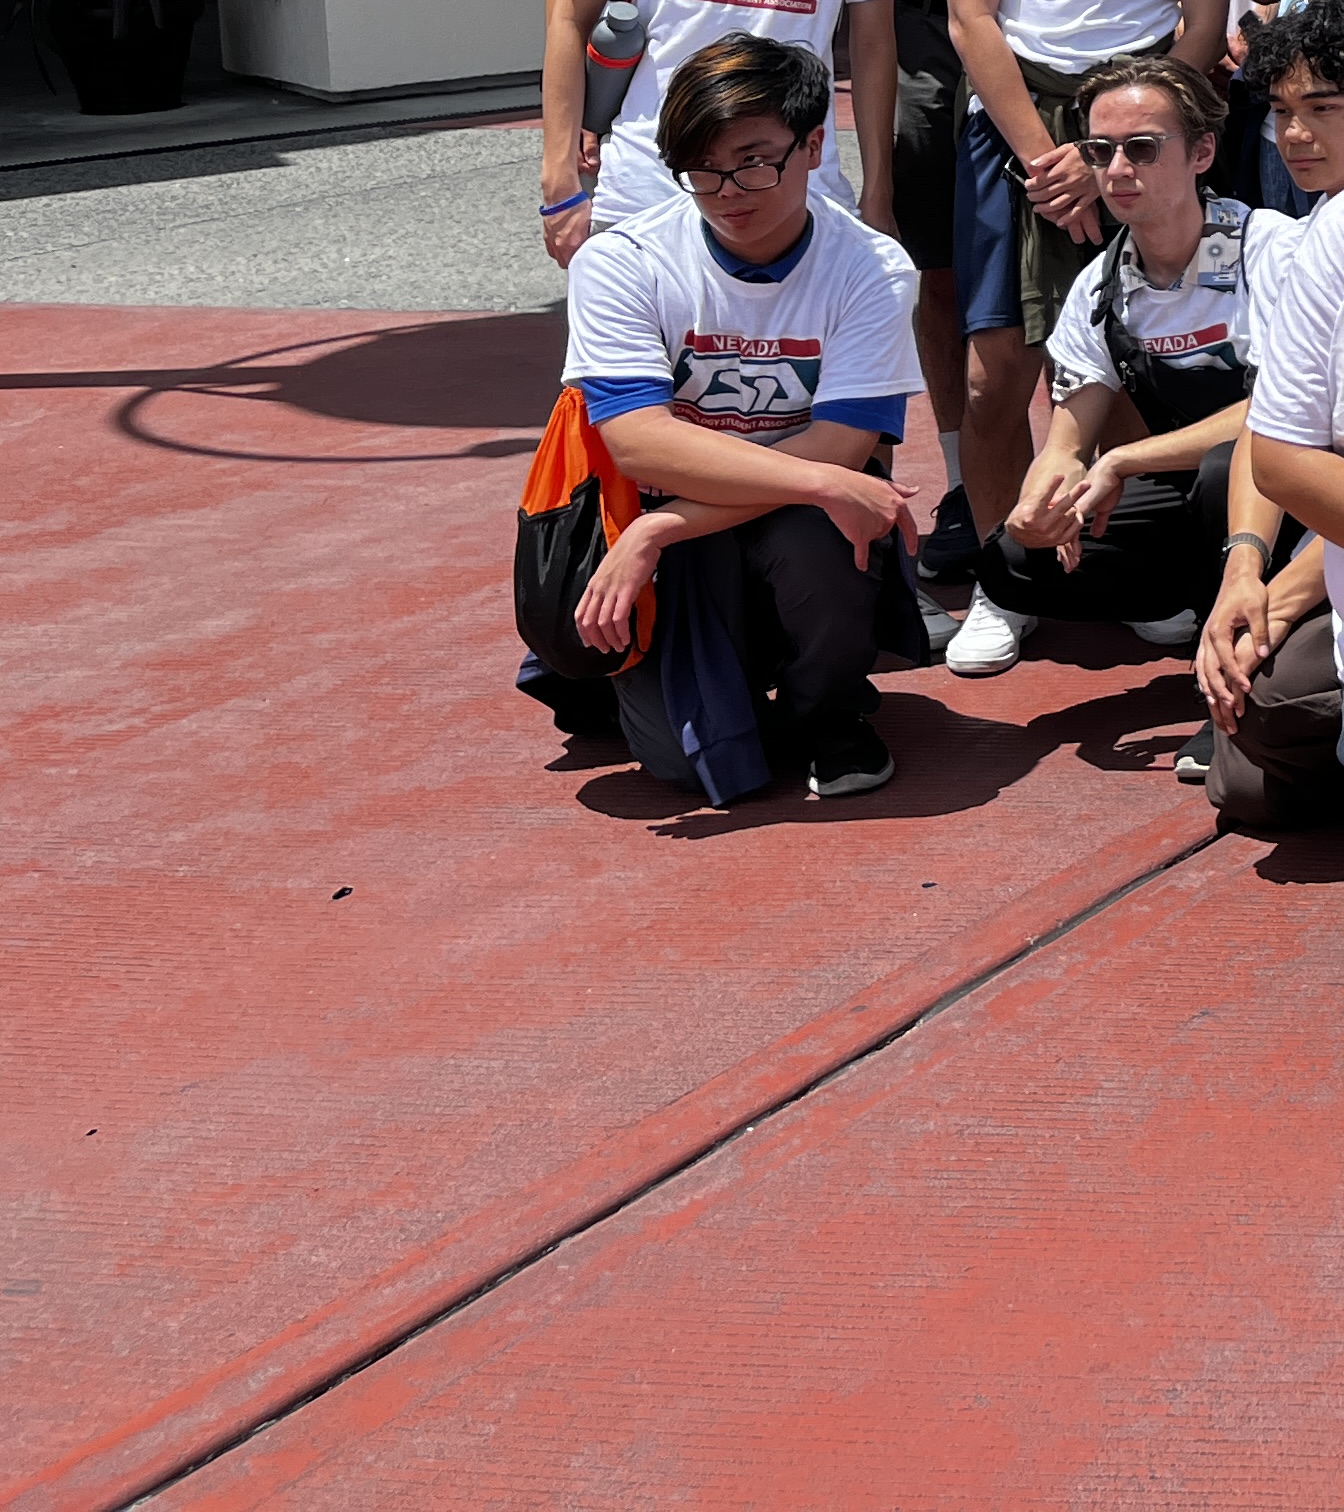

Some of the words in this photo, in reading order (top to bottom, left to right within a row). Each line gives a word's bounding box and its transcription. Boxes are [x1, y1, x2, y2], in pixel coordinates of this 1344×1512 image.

[711, 335, 782, 356] NEVADA
[674, 353, 813, 412] TSA
[719, 418, 756, 430] STUDENT
